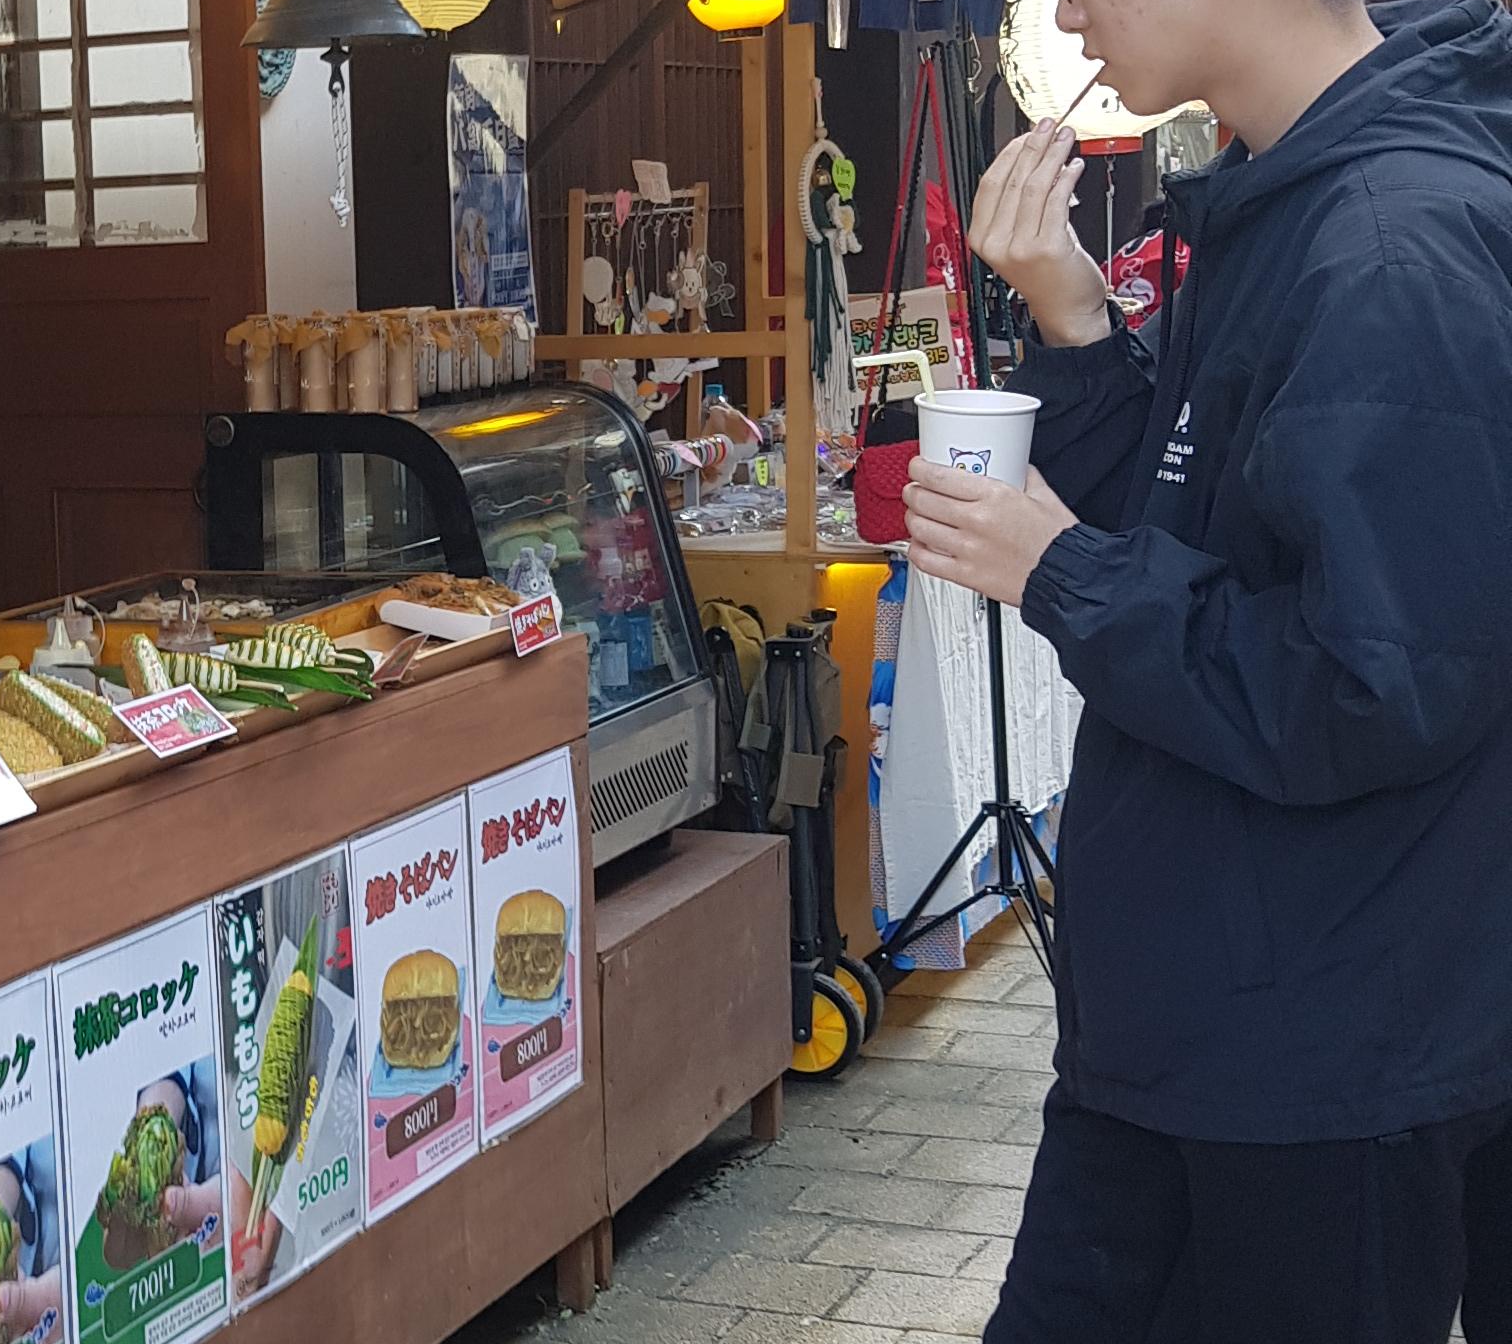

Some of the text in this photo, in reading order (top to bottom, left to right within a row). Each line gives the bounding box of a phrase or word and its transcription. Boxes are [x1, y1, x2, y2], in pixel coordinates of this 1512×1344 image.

[73, 959, 200, 1061] 抹茶コロッケ
[227, 913, 260, 1131] いももち
[517, 1027, 548, 1066] 800円
[404, 1097, 438, 1139] 800円
[297, 1154, 350, 1212] 500円
[128, 1258, 175, 1314] 700円
